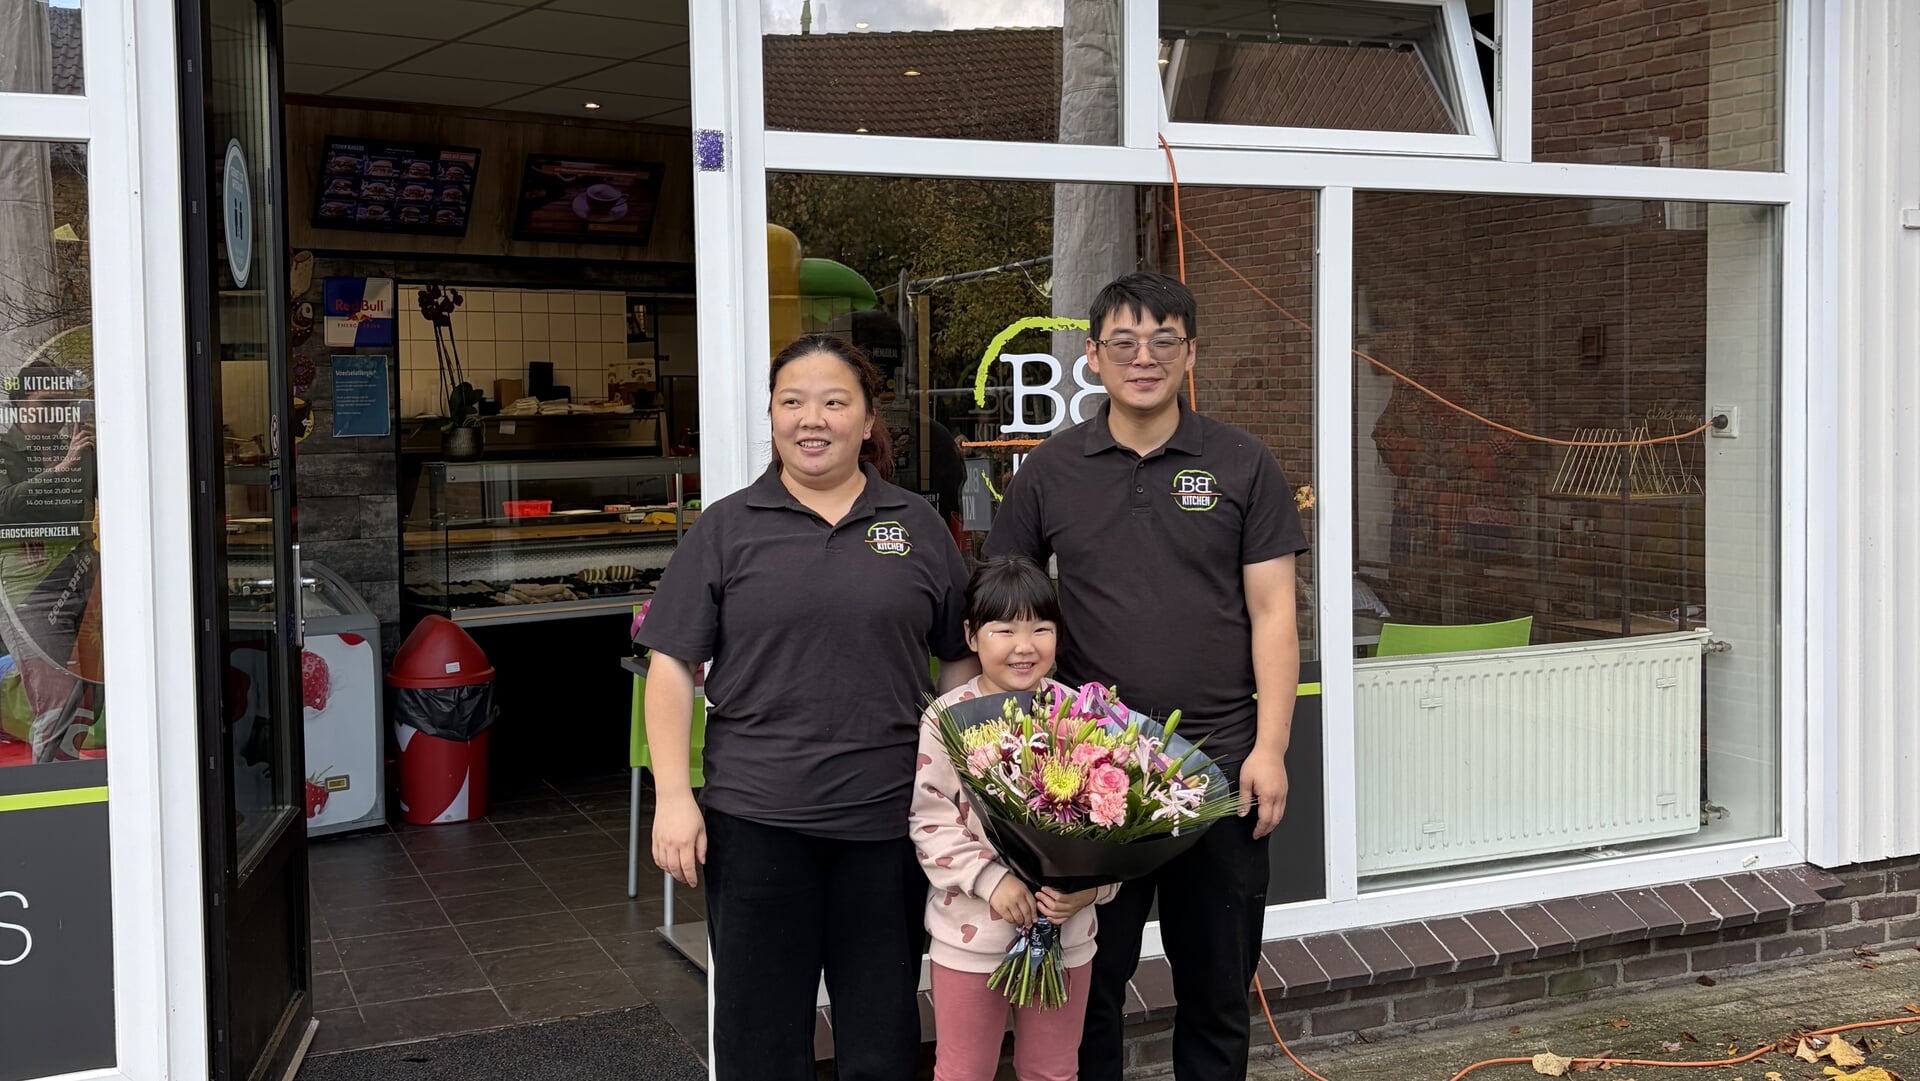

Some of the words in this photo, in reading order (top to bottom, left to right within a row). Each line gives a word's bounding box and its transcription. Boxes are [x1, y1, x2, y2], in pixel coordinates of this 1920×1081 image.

[335, 298, 360, 311] Red
[361, 299, 384, 311] Bull
[24, 376, 74, 391] KITCHEN
[0, 406, 80, 424] INGSTIJDEN
[1178, 476, 1212, 493] BB
[1181, 495, 1210, 507] KITCHEN
[0, 525, 80, 539] EADSCHERPENZEEL.NL
[872, 527, 905, 541] BB
[876, 541, 904, 553] KITCHEN
[47, 590, 71, 625] geen
[68, 555, 90, 592] prijs
